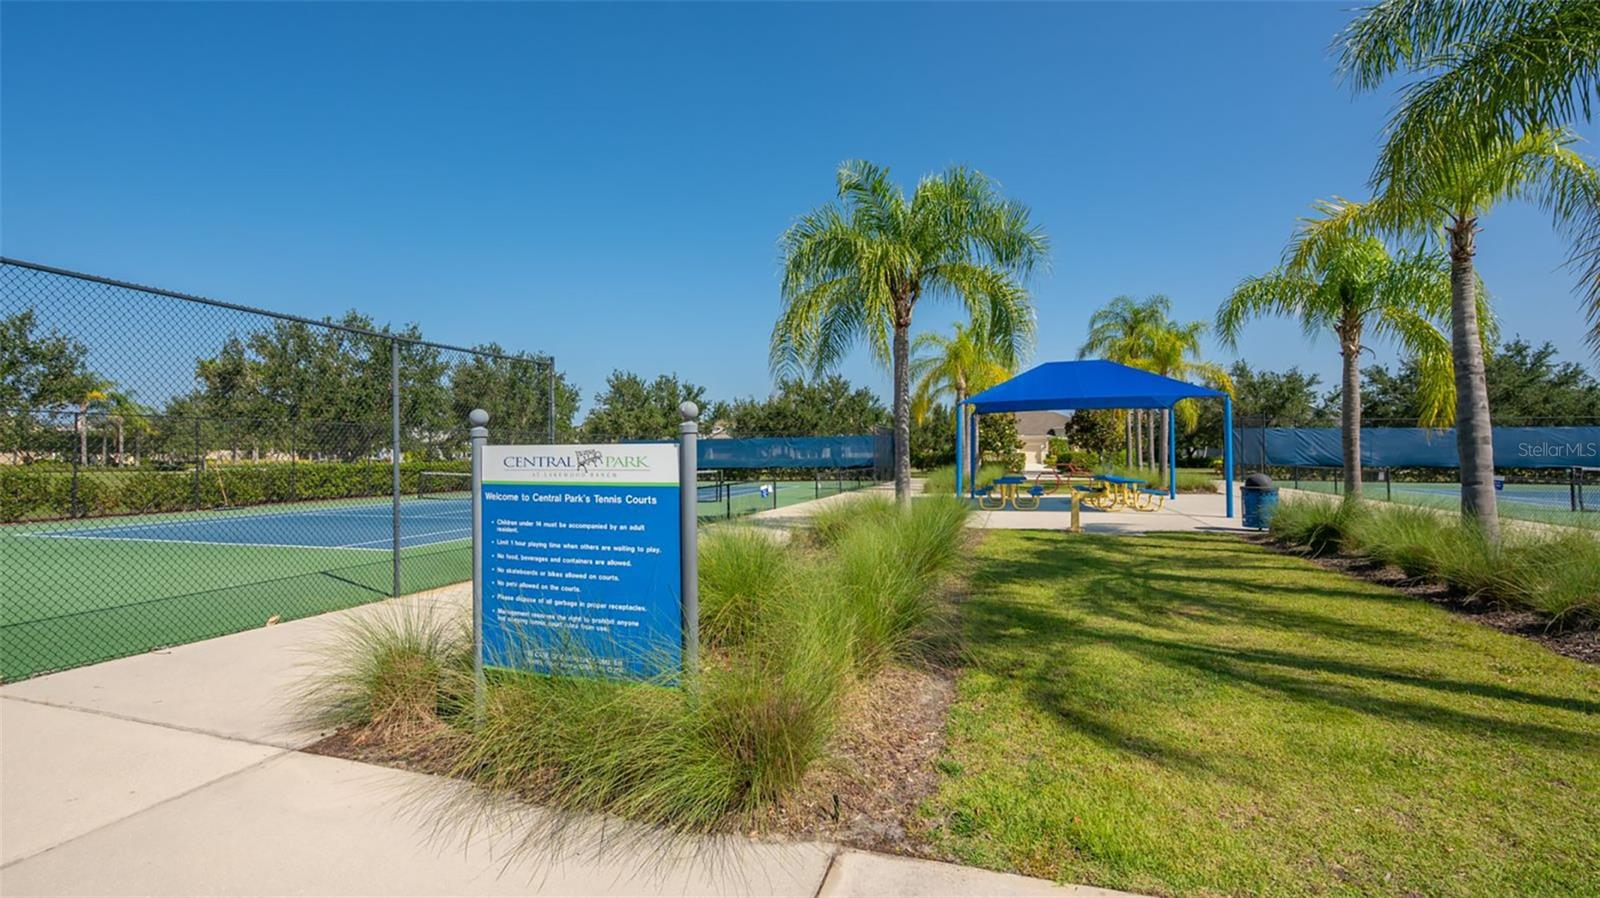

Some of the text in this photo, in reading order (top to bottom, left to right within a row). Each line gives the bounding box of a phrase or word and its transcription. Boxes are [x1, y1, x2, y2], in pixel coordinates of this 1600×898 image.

[503, 455, 650, 468] CENTRAL PARK
[484, 492, 657, 504] Welcome to Central Park's Tennis Courts
[528, 541, 547, 549] playing
[613, 546, 636, 554] waiting
[646, 547, 662, 555] play.
[520, 554, 548, 563] beverages
[506, 568, 538, 576] skateboards
[564, 572, 587, 580] allowed
[598, 574, 620, 582] courts.
[516, 596, 536, 604] dispose
[554, 600, 578, 608] garbage
[586, 602, 608, 610] proper
[608, 604, 648, 612] receptacles.
[592, 618, 616, 626] prohibit
[617, 620, 640, 628] anyone
